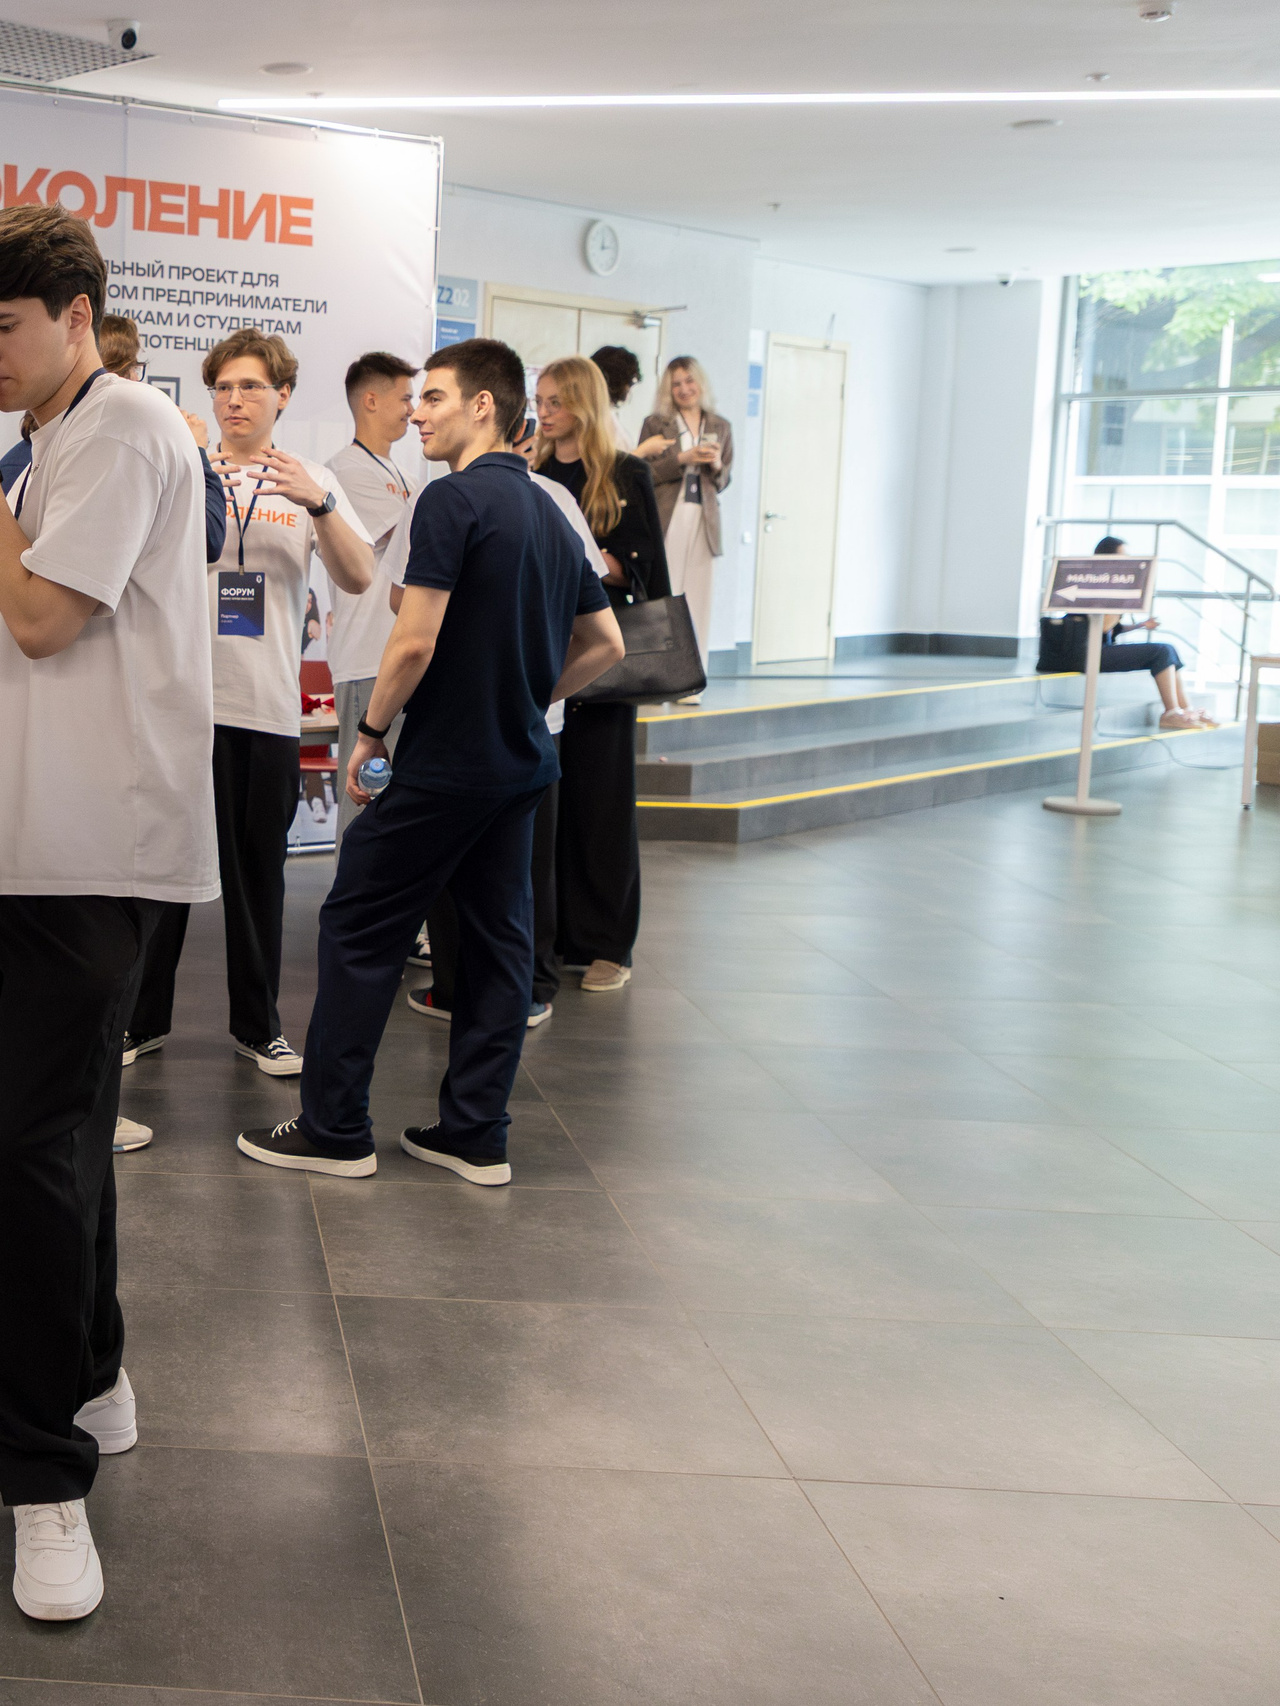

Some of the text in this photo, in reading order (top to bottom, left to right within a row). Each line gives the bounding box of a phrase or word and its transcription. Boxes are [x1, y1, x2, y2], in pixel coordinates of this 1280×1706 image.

[168, 265, 238, 284] ПРОЕКТ
[241, 271, 279, 288] ДЛЯ
[108, 284, 138, 300] ОМ
[143, 286, 327, 314] ПРЕДПРИНИМАТЕЛИ
[177, 312, 190, 327] И
[194, 314, 302, 334] СТУДЕНТАМ
[139, 333, 223, 351] ПОТЕНЦ
[221, 588, 254, 596] ФОРУМ
